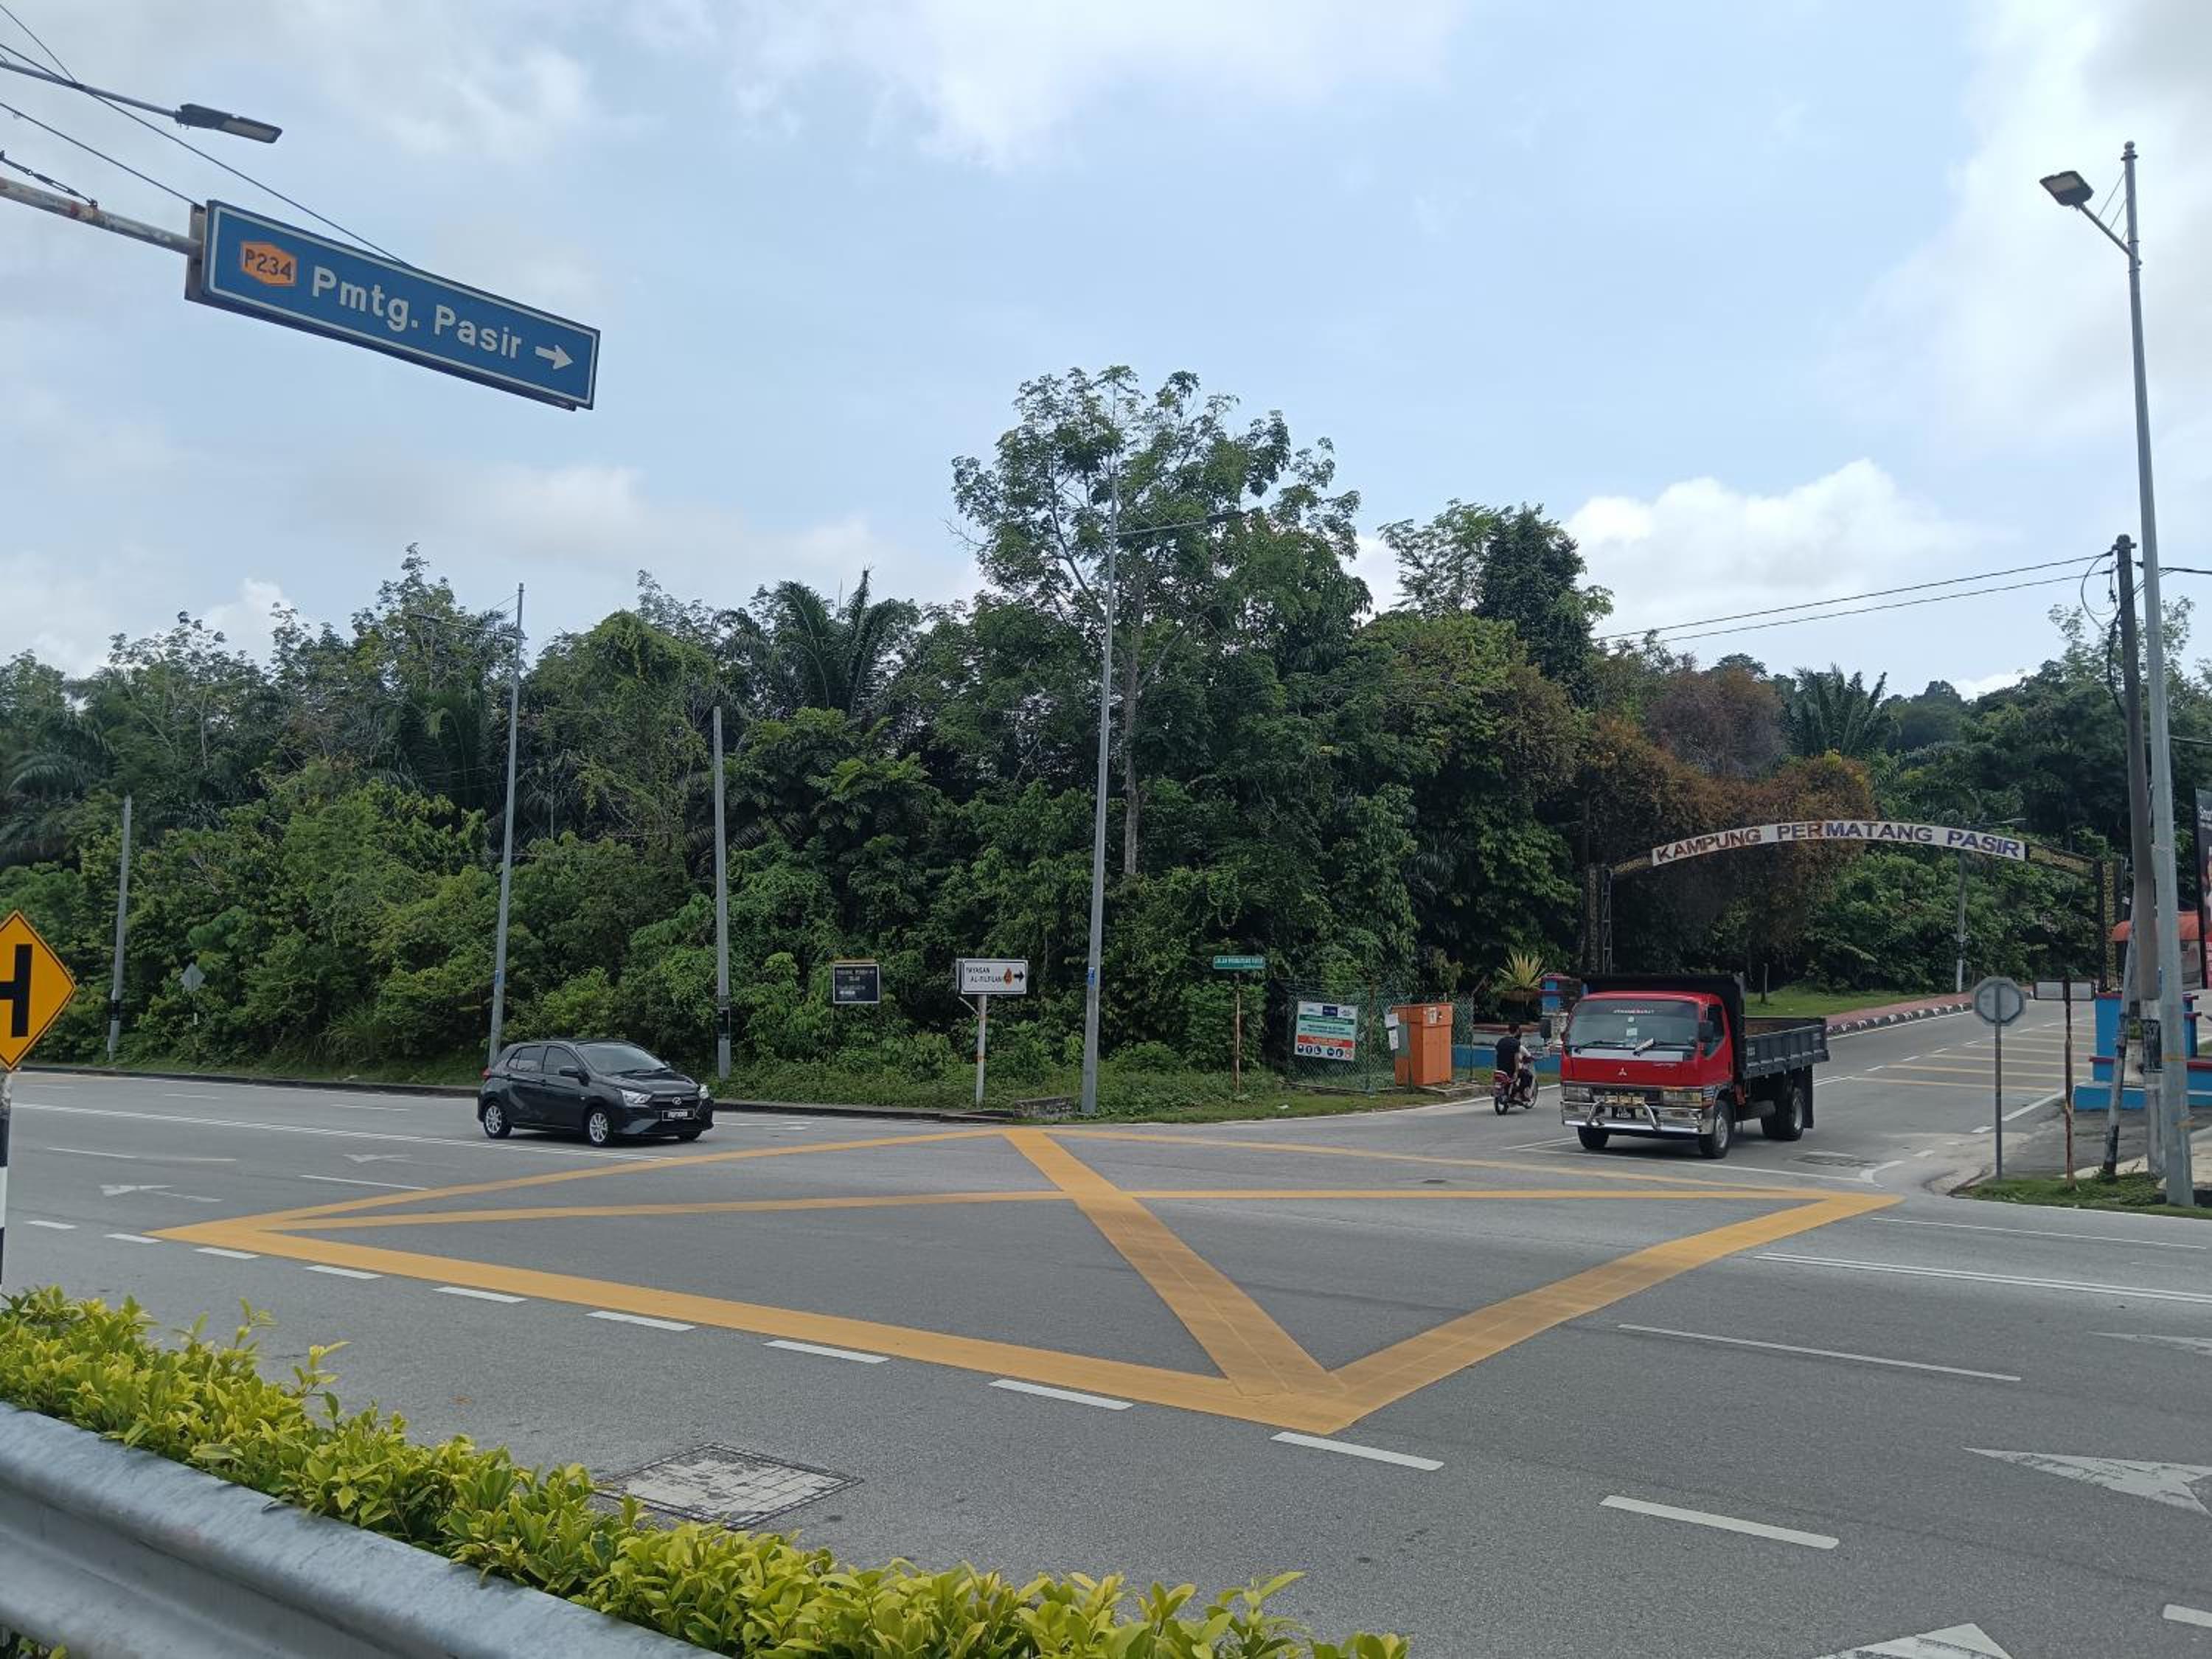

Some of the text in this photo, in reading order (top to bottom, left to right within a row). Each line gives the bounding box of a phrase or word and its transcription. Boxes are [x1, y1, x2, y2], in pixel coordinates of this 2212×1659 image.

[245, 248, 292, 281] P234
[312, 265, 522, 359] Pmtg. Pasir
[1657, 822, 2021, 862] KAMPUNG PERMATANG PASIR
